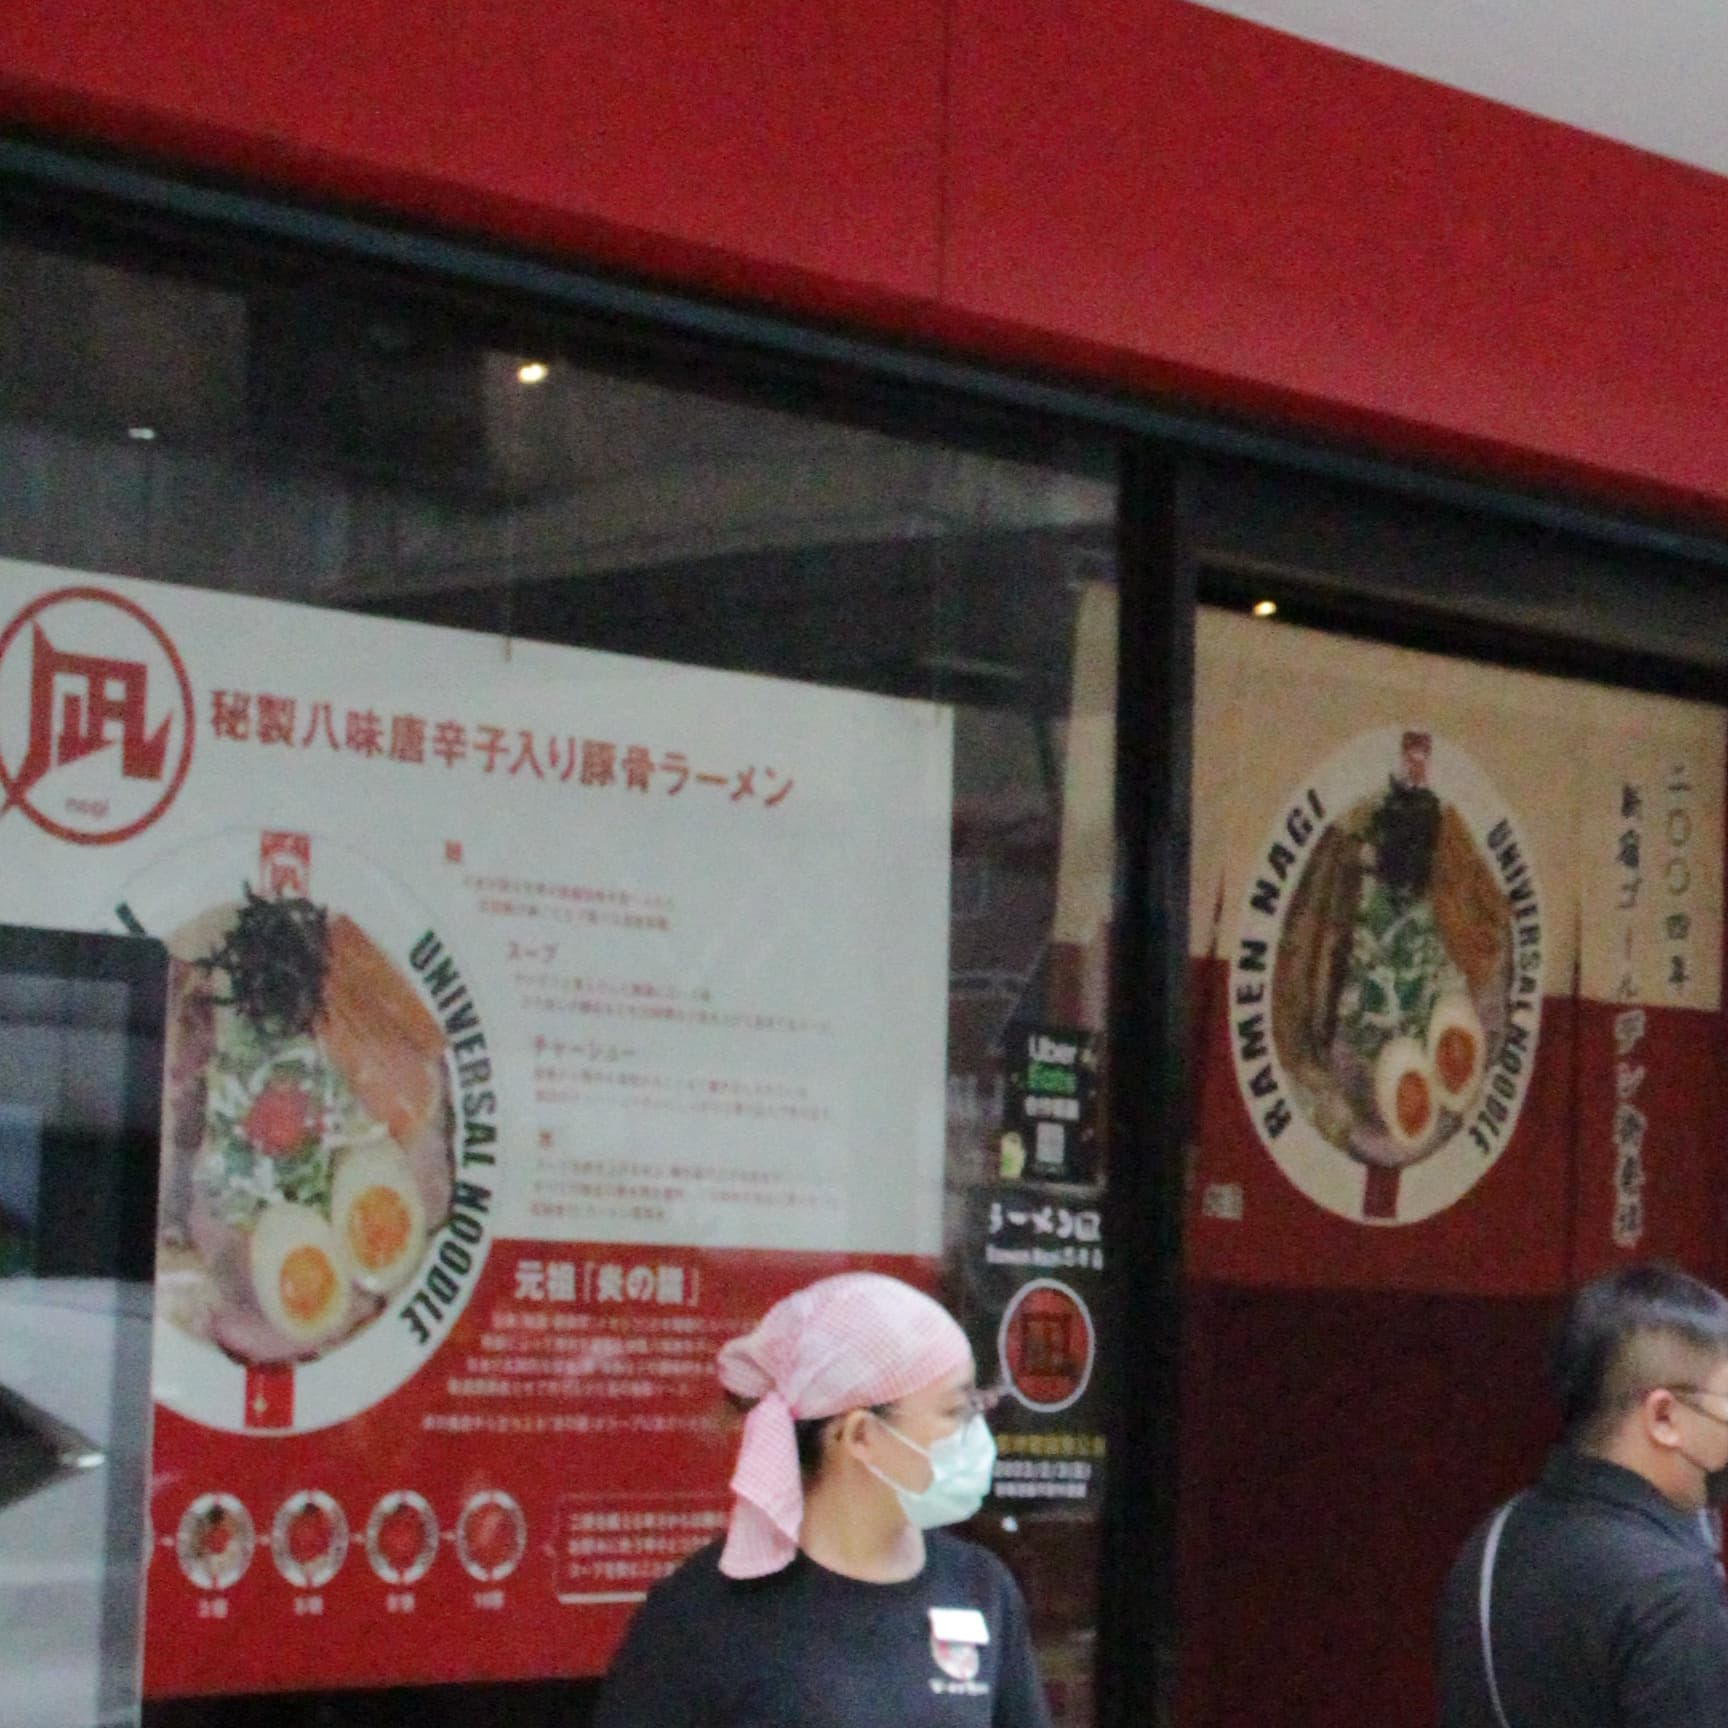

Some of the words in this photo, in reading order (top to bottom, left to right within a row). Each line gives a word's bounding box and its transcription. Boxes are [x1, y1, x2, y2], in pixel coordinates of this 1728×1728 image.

[1250, 787, 1326, 915] NAGI
[409, 928, 497, 1170] UNIVERSAL
[1236, 939, 1292, 1139] RAMEN
[400, 1184, 494, 1346] NOODLE
